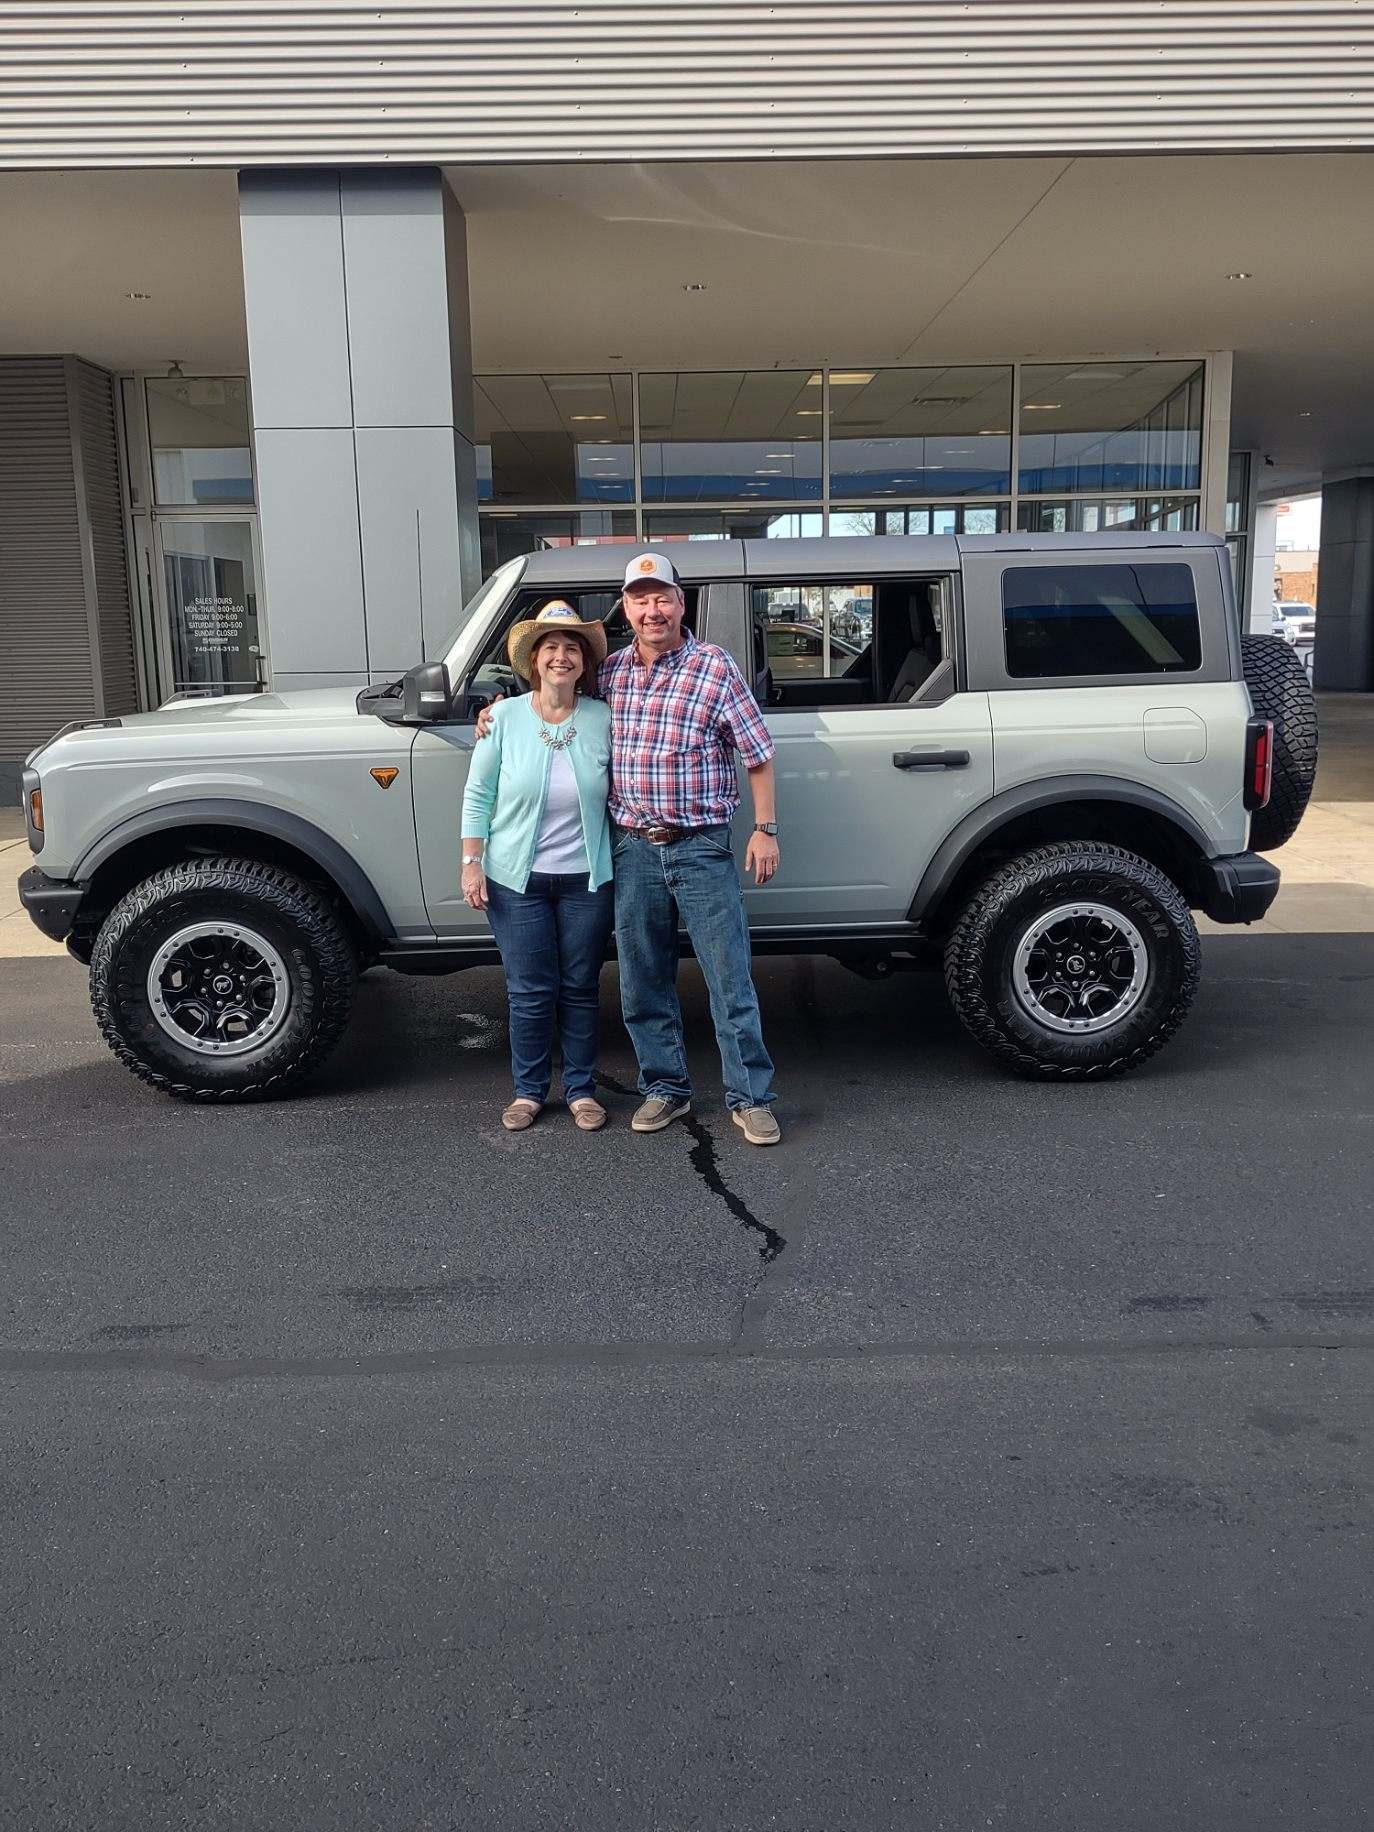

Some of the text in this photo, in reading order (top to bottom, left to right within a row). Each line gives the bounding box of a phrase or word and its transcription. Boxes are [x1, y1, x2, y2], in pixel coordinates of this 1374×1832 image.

[195, 597, 233, 605] SALES HOURS
[191, 613, 210, 621] FRIDAY
[188, 621, 215, 629] SATURDAY
[194, 629, 238, 637] SUNDAY CLOSED
